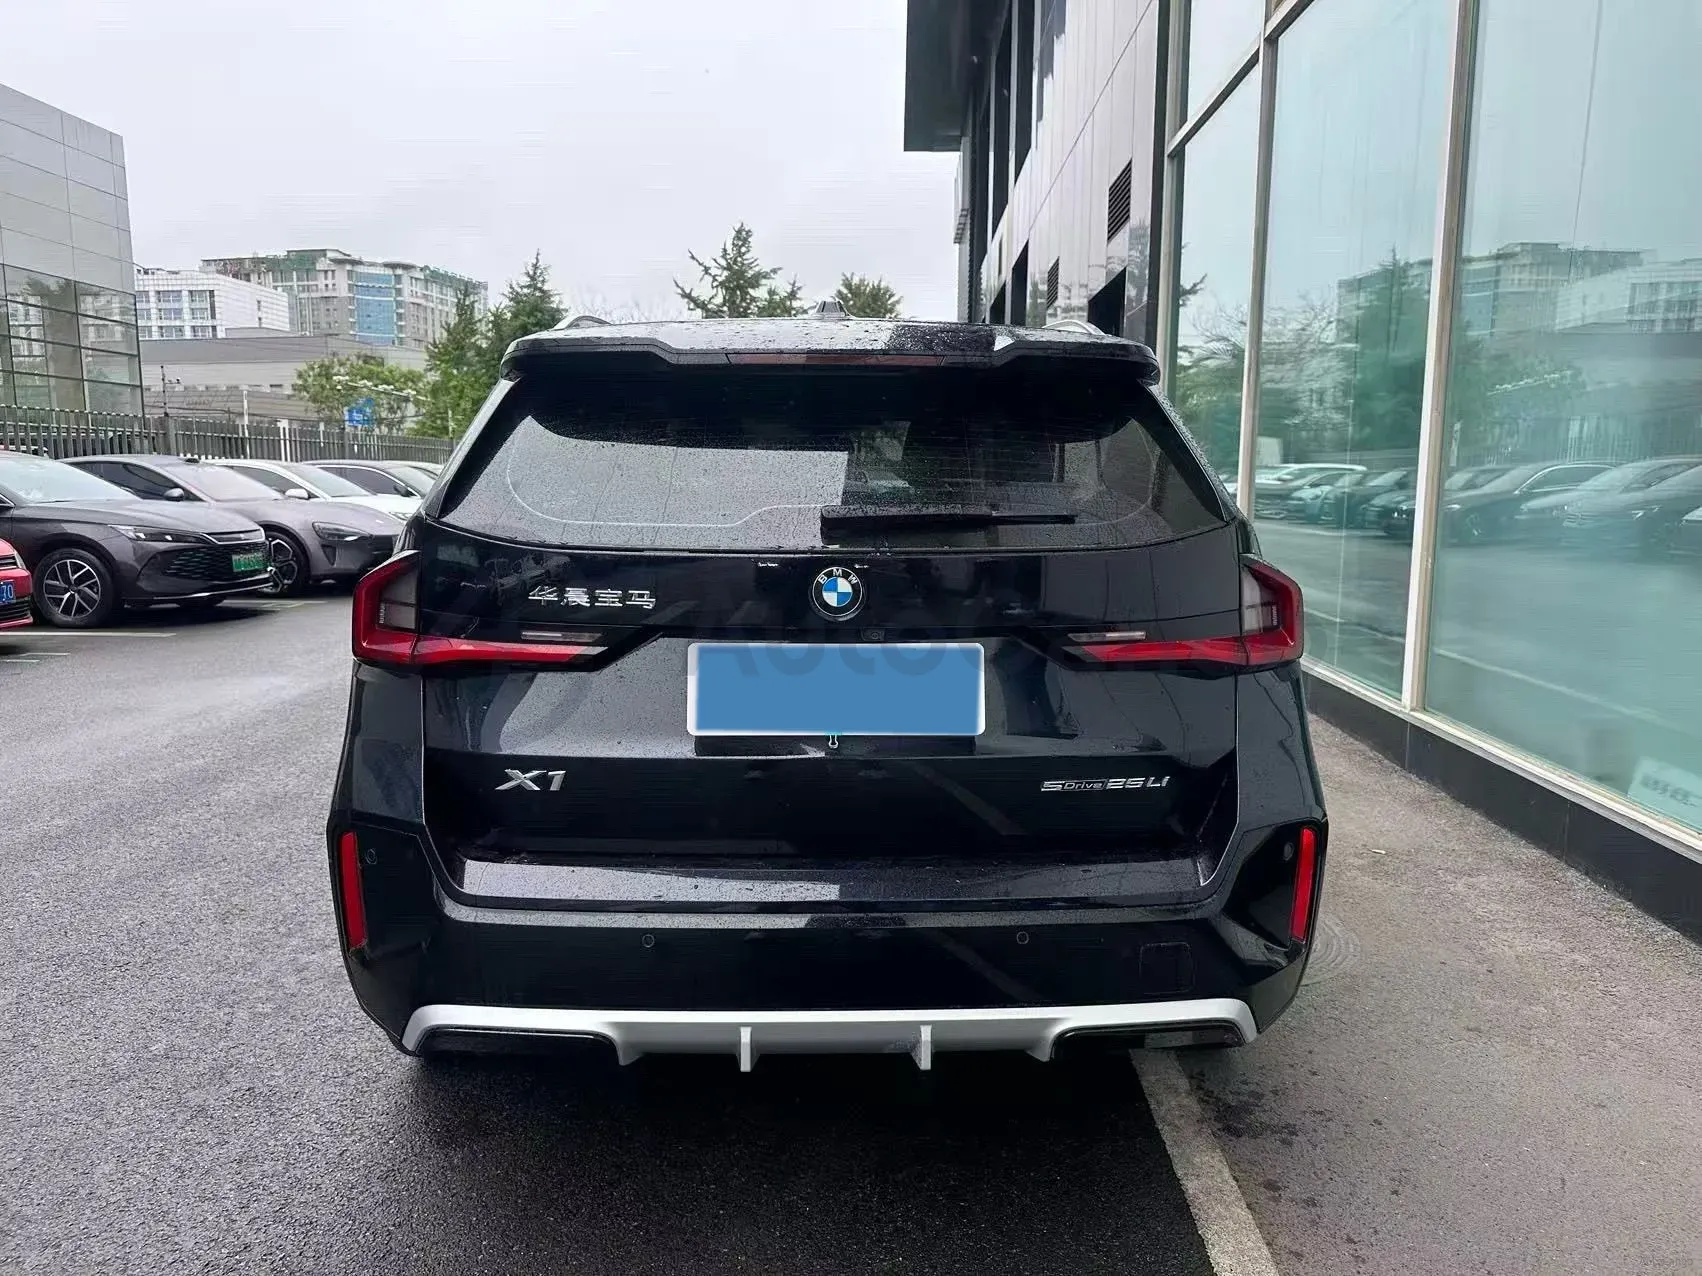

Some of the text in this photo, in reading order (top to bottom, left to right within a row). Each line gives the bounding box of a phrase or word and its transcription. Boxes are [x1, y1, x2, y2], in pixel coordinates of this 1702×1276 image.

[528, 585, 656, 609] 华晨宝马
[494, 768, 567, 792] X1
